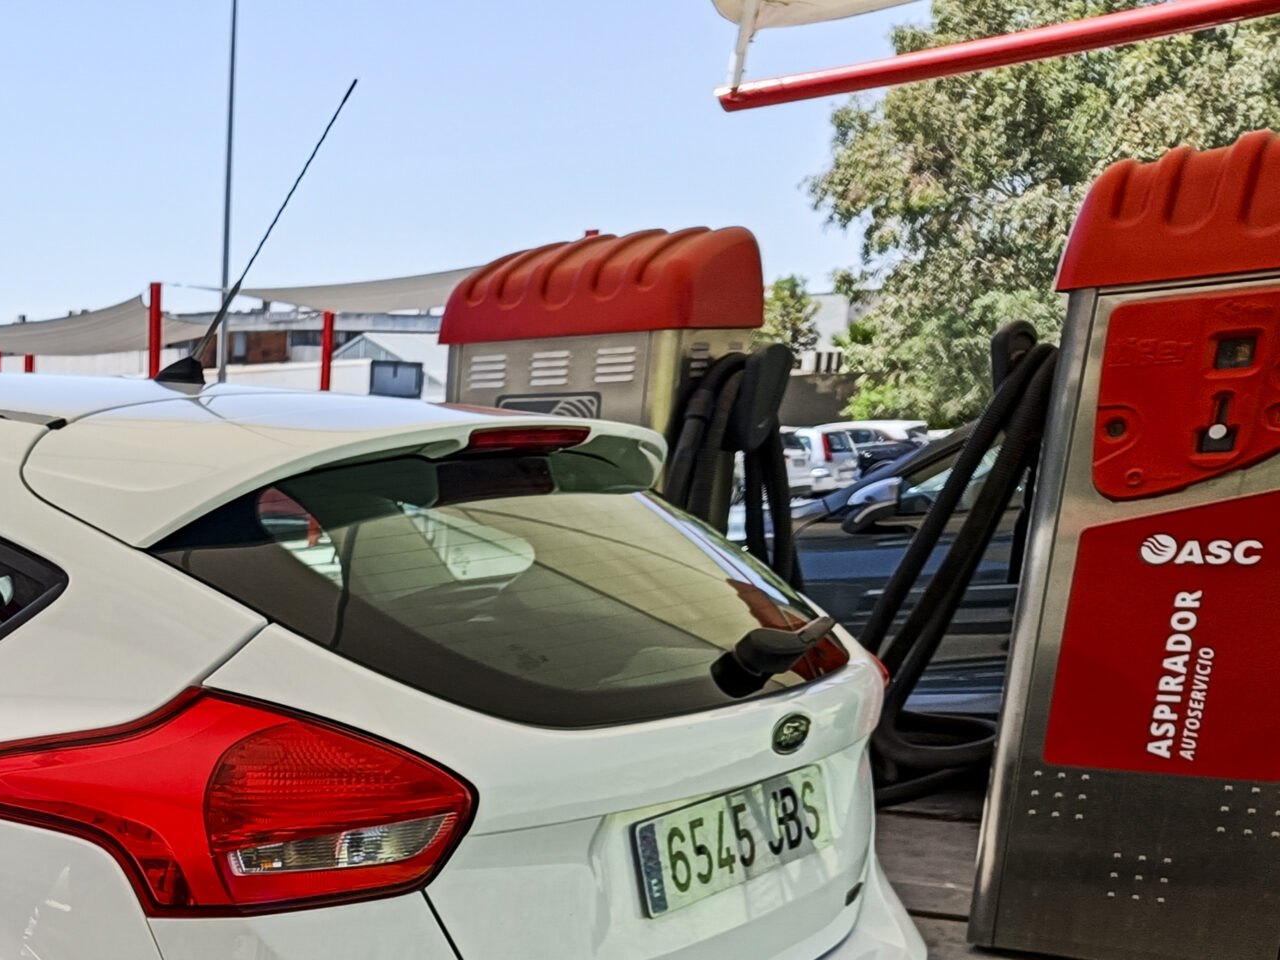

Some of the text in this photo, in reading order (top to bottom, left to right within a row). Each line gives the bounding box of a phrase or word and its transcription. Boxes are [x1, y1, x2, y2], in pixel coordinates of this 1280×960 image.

[1174, 540, 1264, 565] ASC
[1147, 589, 1203, 759] ASPIRADOR
[1179, 647, 1215, 761] AUTOSERVICIO
[651, 878, 662, 898] E
[667, 781, 820, 893] 6545 JBS
